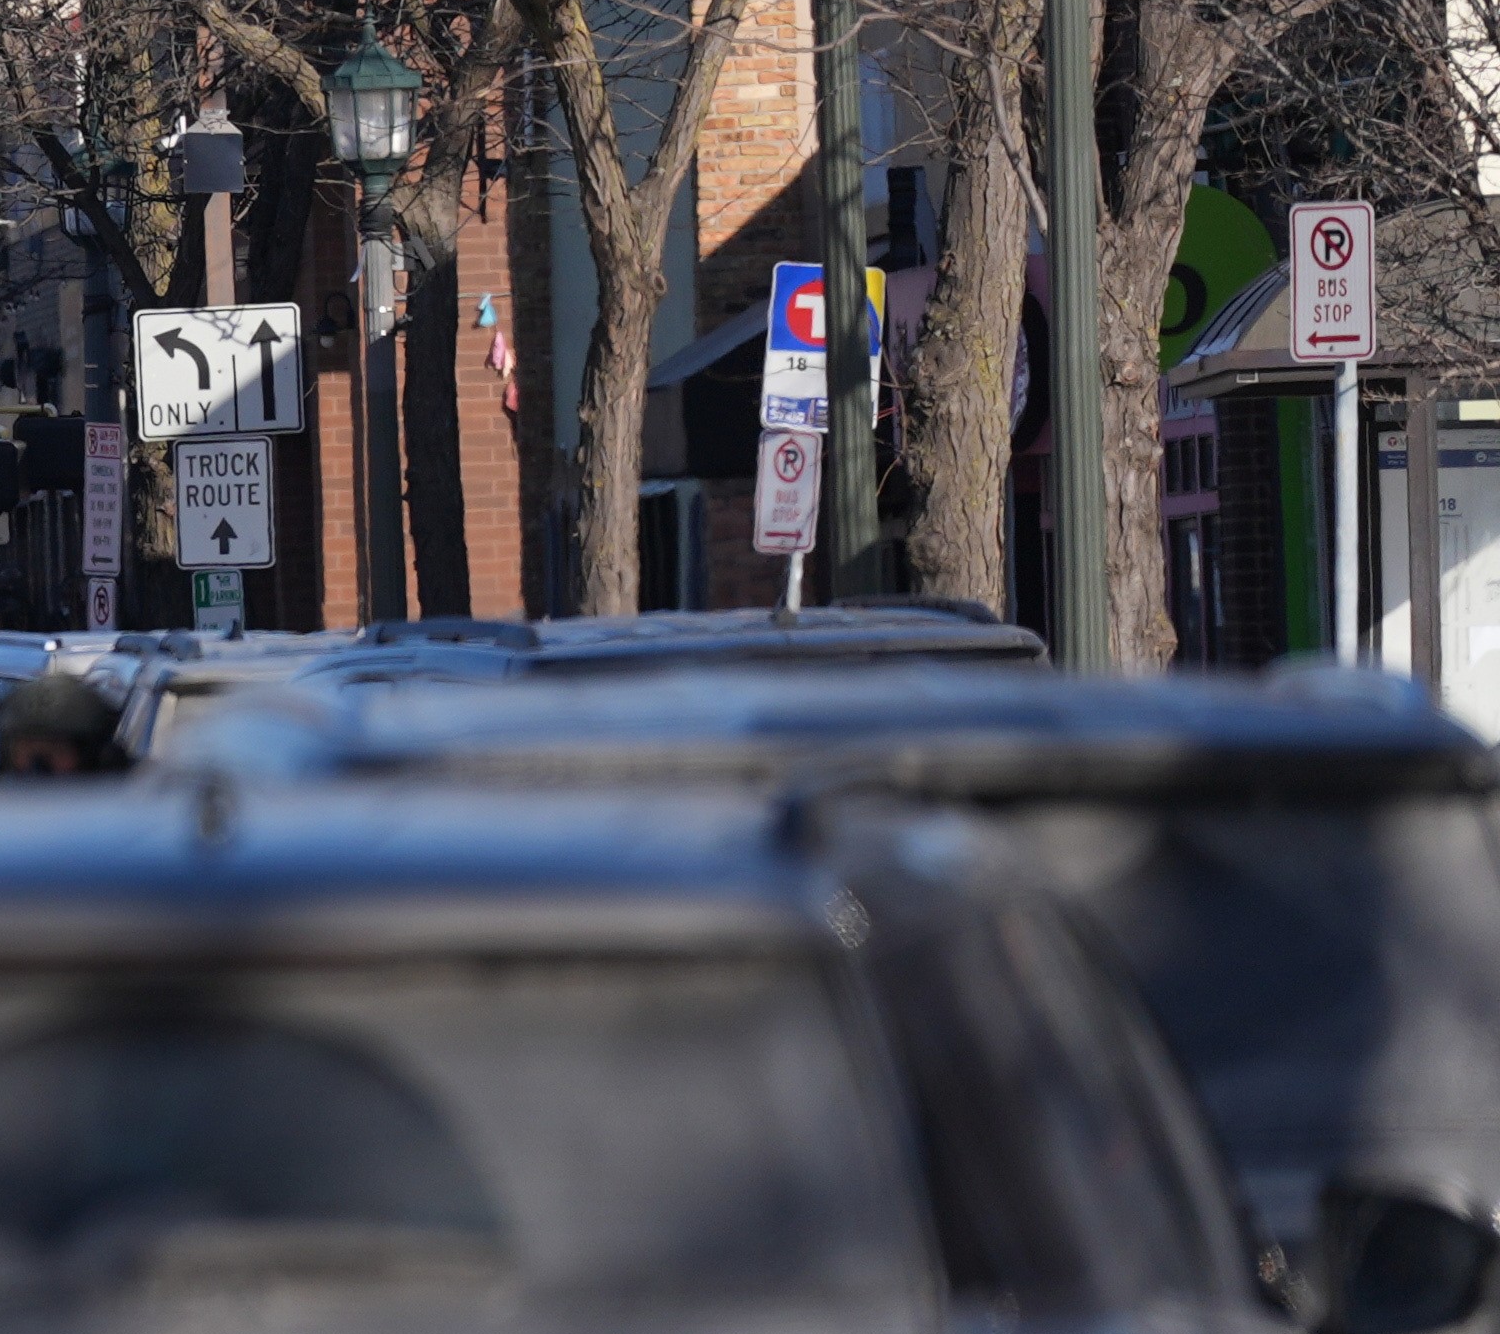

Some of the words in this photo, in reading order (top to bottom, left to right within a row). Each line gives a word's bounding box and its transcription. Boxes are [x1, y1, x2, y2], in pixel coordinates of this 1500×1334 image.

[1317, 278, 1348, 298] BUS
[1313, 305, 1353, 324] STOP
[786, 356, 808, 372] 18
[150, 401, 212, 427] ONLY
[185, 452, 260, 478] TRUCK
[186, 483, 261, 508] ROUTE
[1439, 497, 1457, 511] 18
